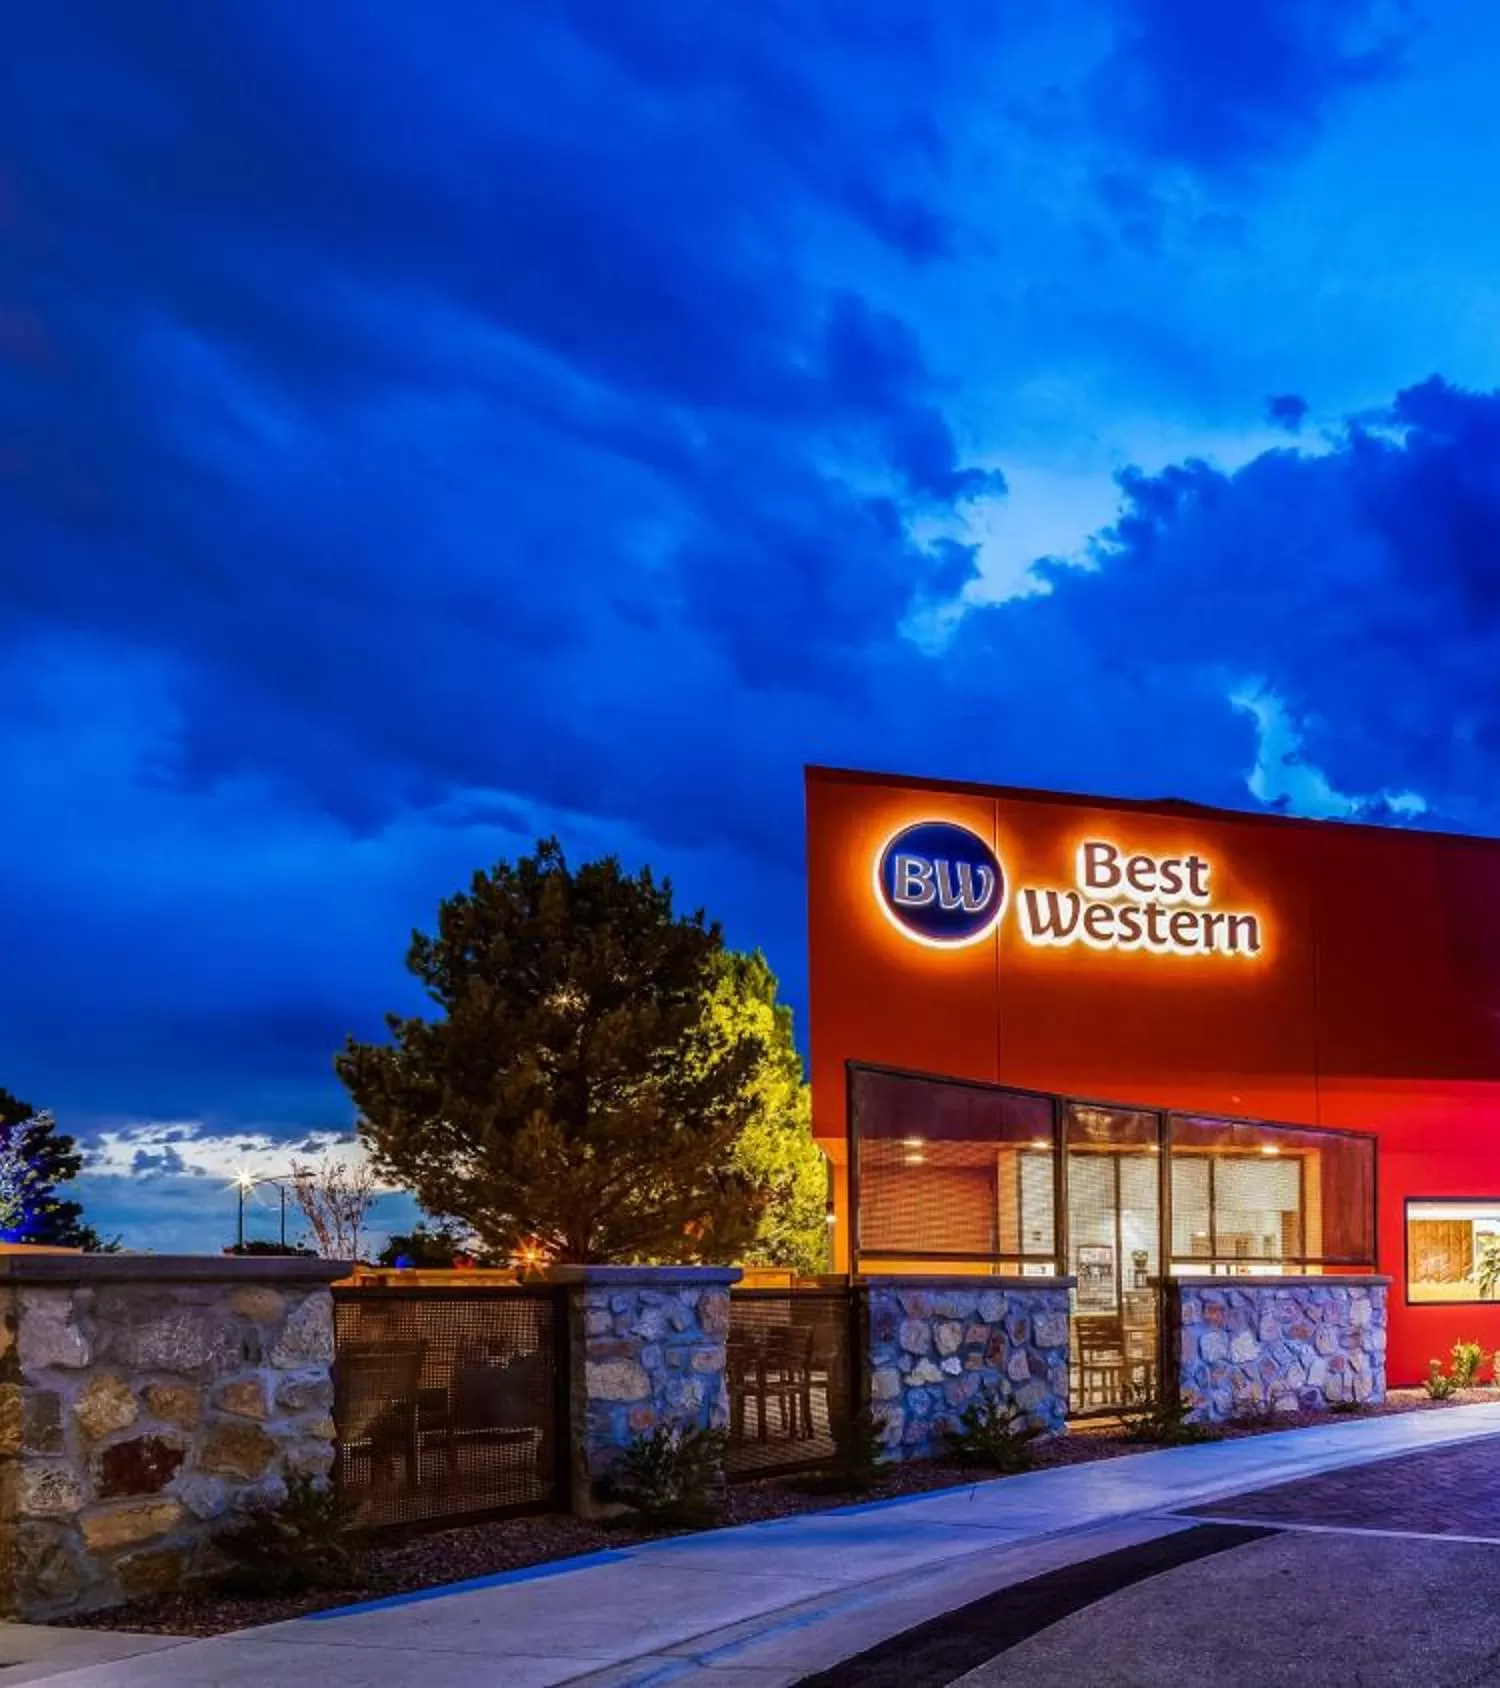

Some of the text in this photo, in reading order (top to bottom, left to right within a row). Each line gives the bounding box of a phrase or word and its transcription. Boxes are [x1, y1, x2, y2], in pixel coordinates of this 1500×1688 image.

[893, 854, 995, 911] BW
[1083, 841, 1210, 897] Best
[1023, 888, 1262, 953] Western
